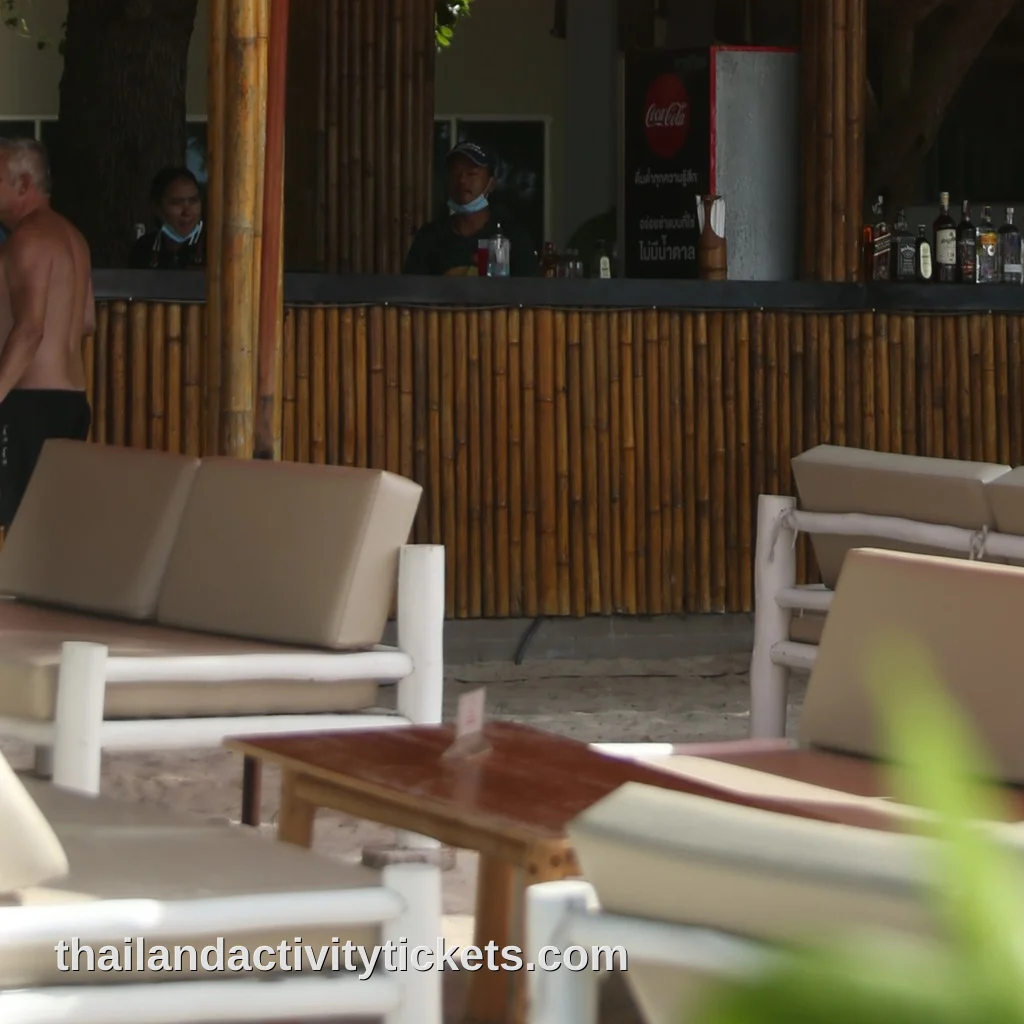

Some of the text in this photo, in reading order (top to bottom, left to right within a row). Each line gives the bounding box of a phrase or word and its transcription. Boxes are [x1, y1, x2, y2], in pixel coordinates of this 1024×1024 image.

[639, 234, 696, 260] ไม่มีน้ำตาล
